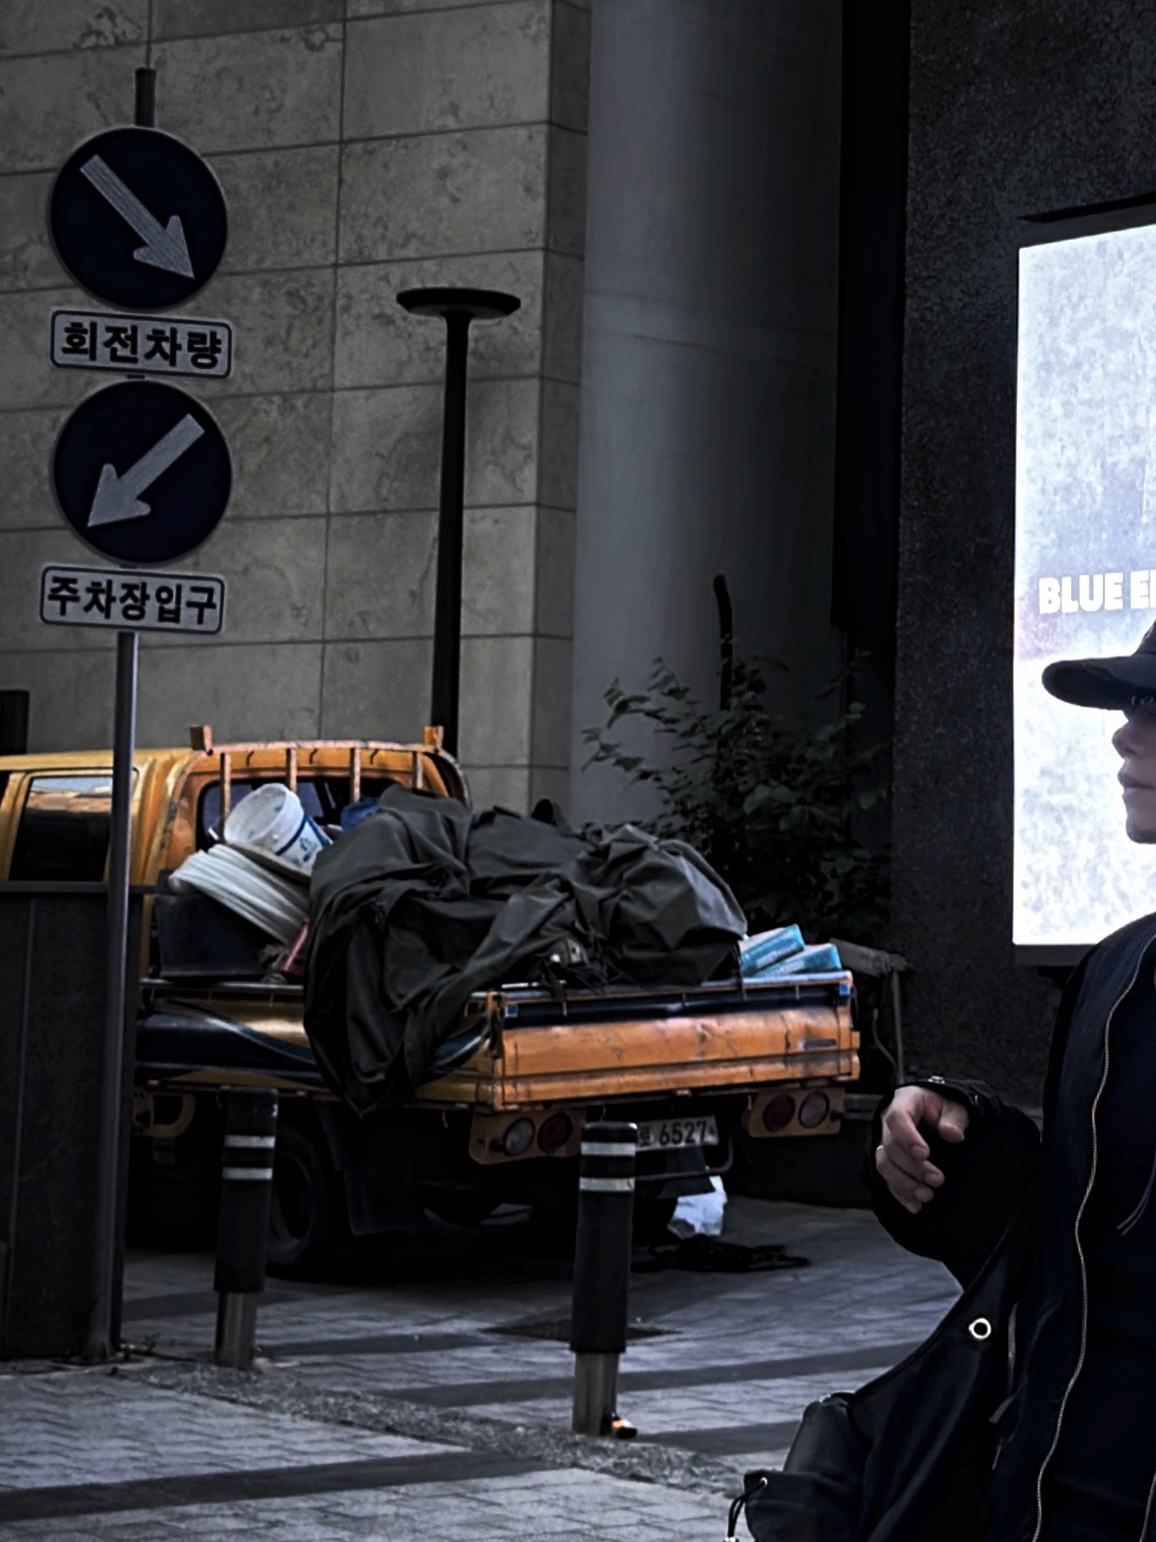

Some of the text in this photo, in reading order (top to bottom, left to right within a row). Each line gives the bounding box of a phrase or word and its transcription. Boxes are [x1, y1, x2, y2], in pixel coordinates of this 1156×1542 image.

[61, 321, 223, 369] 회전차량
[47, 576, 217, 625] 주차장입구
[1038, 572, 1124, 615] BLUE
[659, 1120, 707, 1145] 6527
